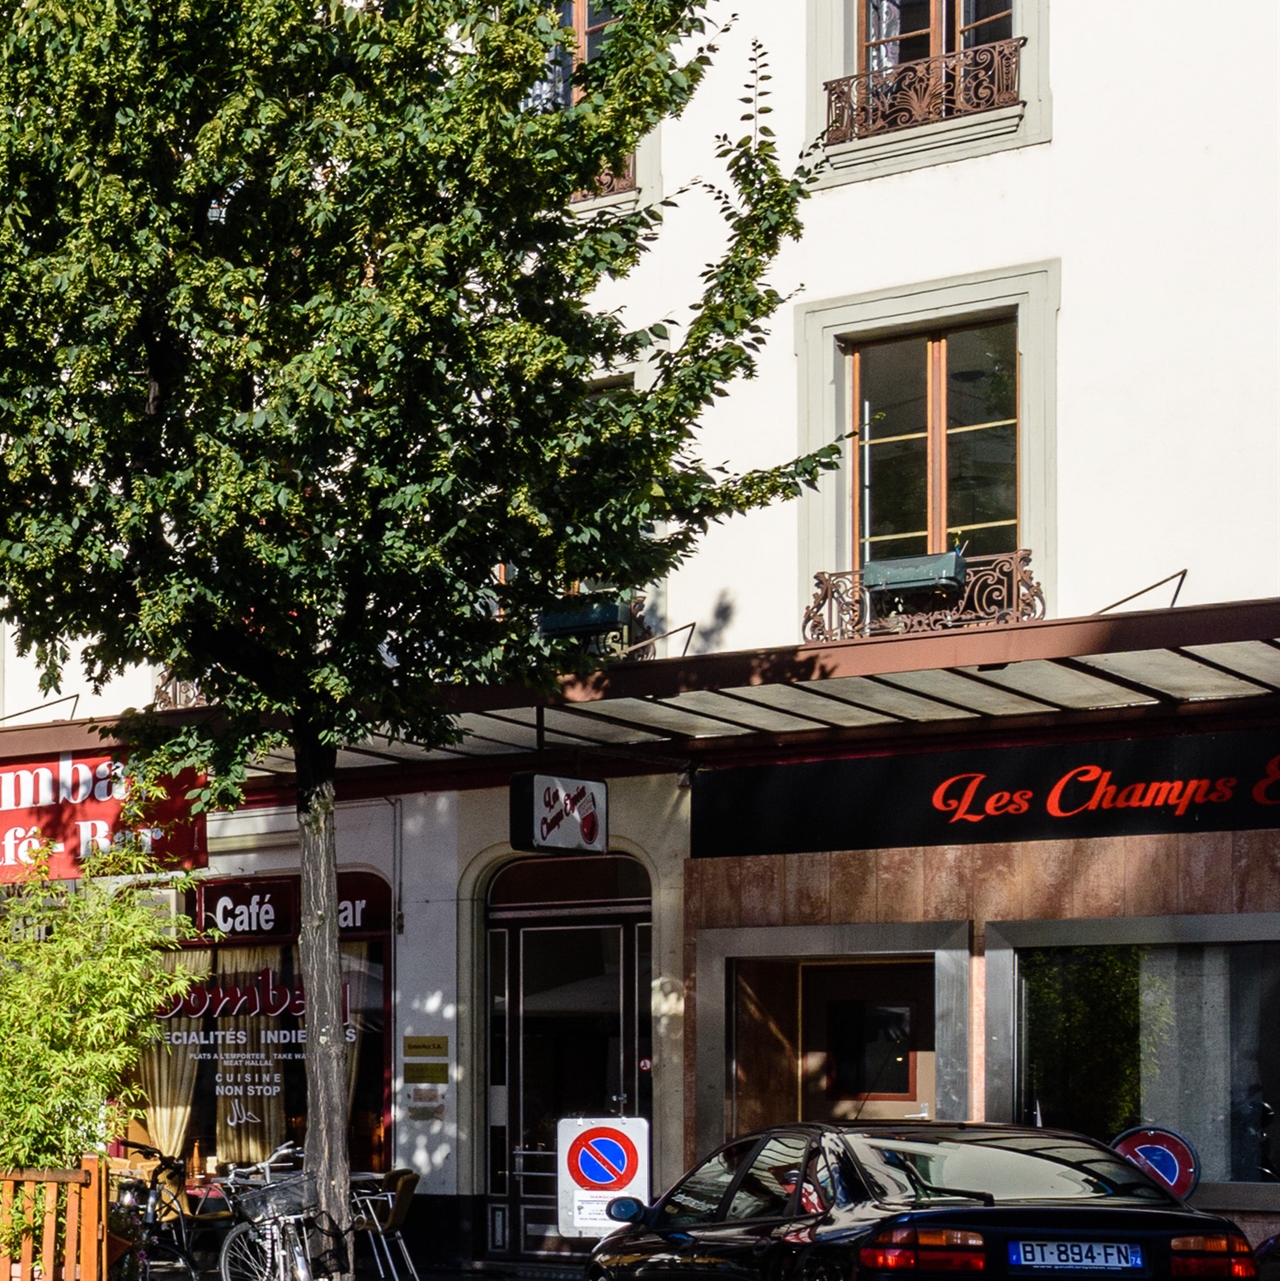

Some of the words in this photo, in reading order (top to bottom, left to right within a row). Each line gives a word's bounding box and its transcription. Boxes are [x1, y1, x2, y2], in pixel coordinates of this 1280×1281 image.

[932, 773, 1033, 823] Les
[1046, 765, 1237, 817] Champs
[76, 820, 165, 859] Bar
[216, 894, 275, 932] Café
[338, 899, 366, 928] ar
[215, 1073, 281, 1084] CUISINE
[215, 1085, 244, 1096] NON
[247, 1085, 282, 1096] STOP
[1021, 1242, 1130, 1265] BT-894-FN
